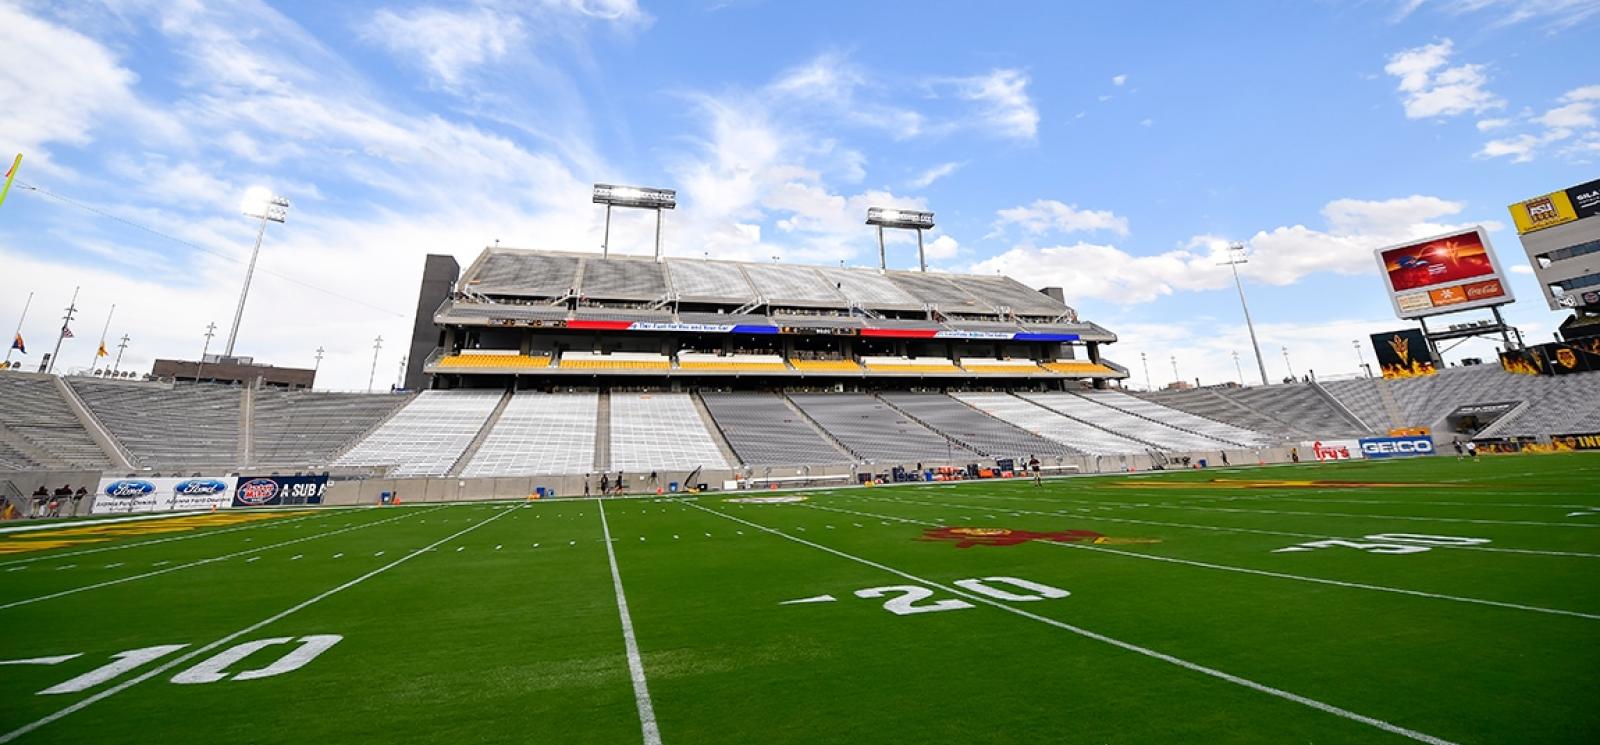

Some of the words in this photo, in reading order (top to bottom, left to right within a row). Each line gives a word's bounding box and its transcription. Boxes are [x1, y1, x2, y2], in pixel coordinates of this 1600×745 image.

[1362, 440, 1432, 454] GEICO
[113, 481, 146, 497] Ford
[183, 480, 218, 495] Ford
[280, 484, 289, 497] A
[292, 483, 317, 497] SUB
[853, 576, 1071, 616] 20
[35, 633, 344, 695] 10
